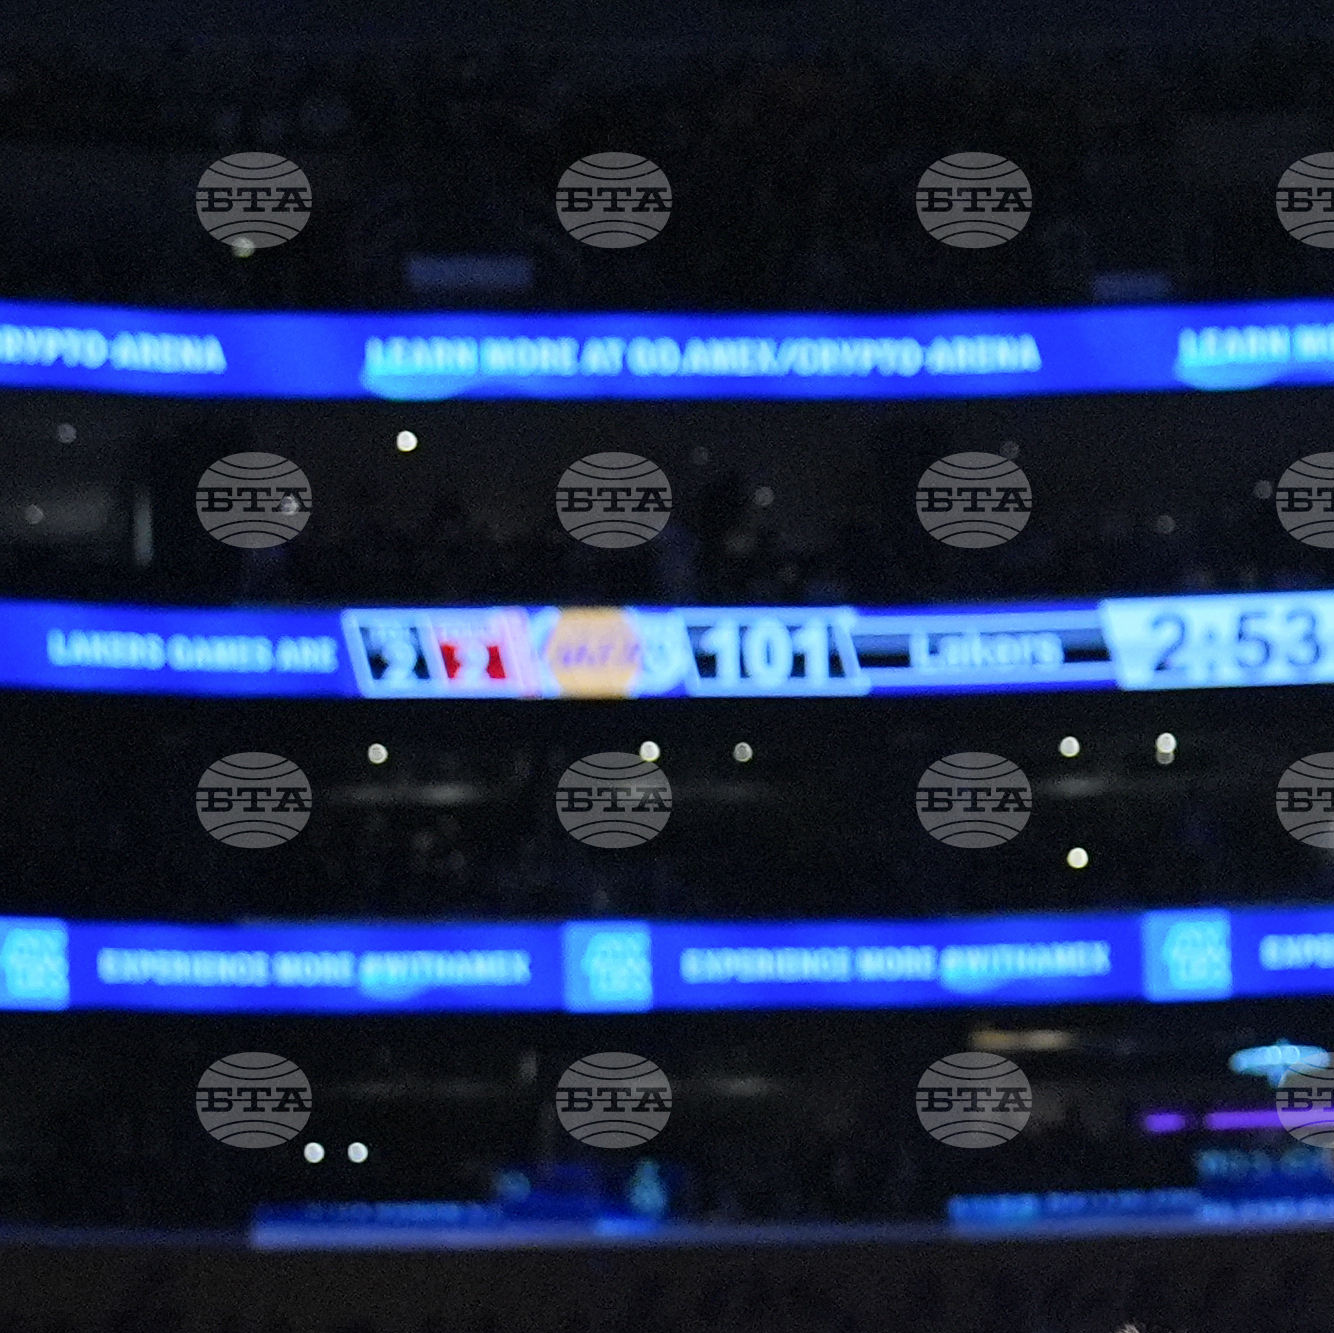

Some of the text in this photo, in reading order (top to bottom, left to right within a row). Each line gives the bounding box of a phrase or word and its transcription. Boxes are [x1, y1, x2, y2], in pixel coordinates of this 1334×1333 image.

[47, 628, 165, 671] LAKERS
[166, 633, 274, 673] GAMES
[701, 616, 832, 689] 101
[909, 626, 1064, 675] Lakers
[1151, 609, 1322, 673] 2:53
